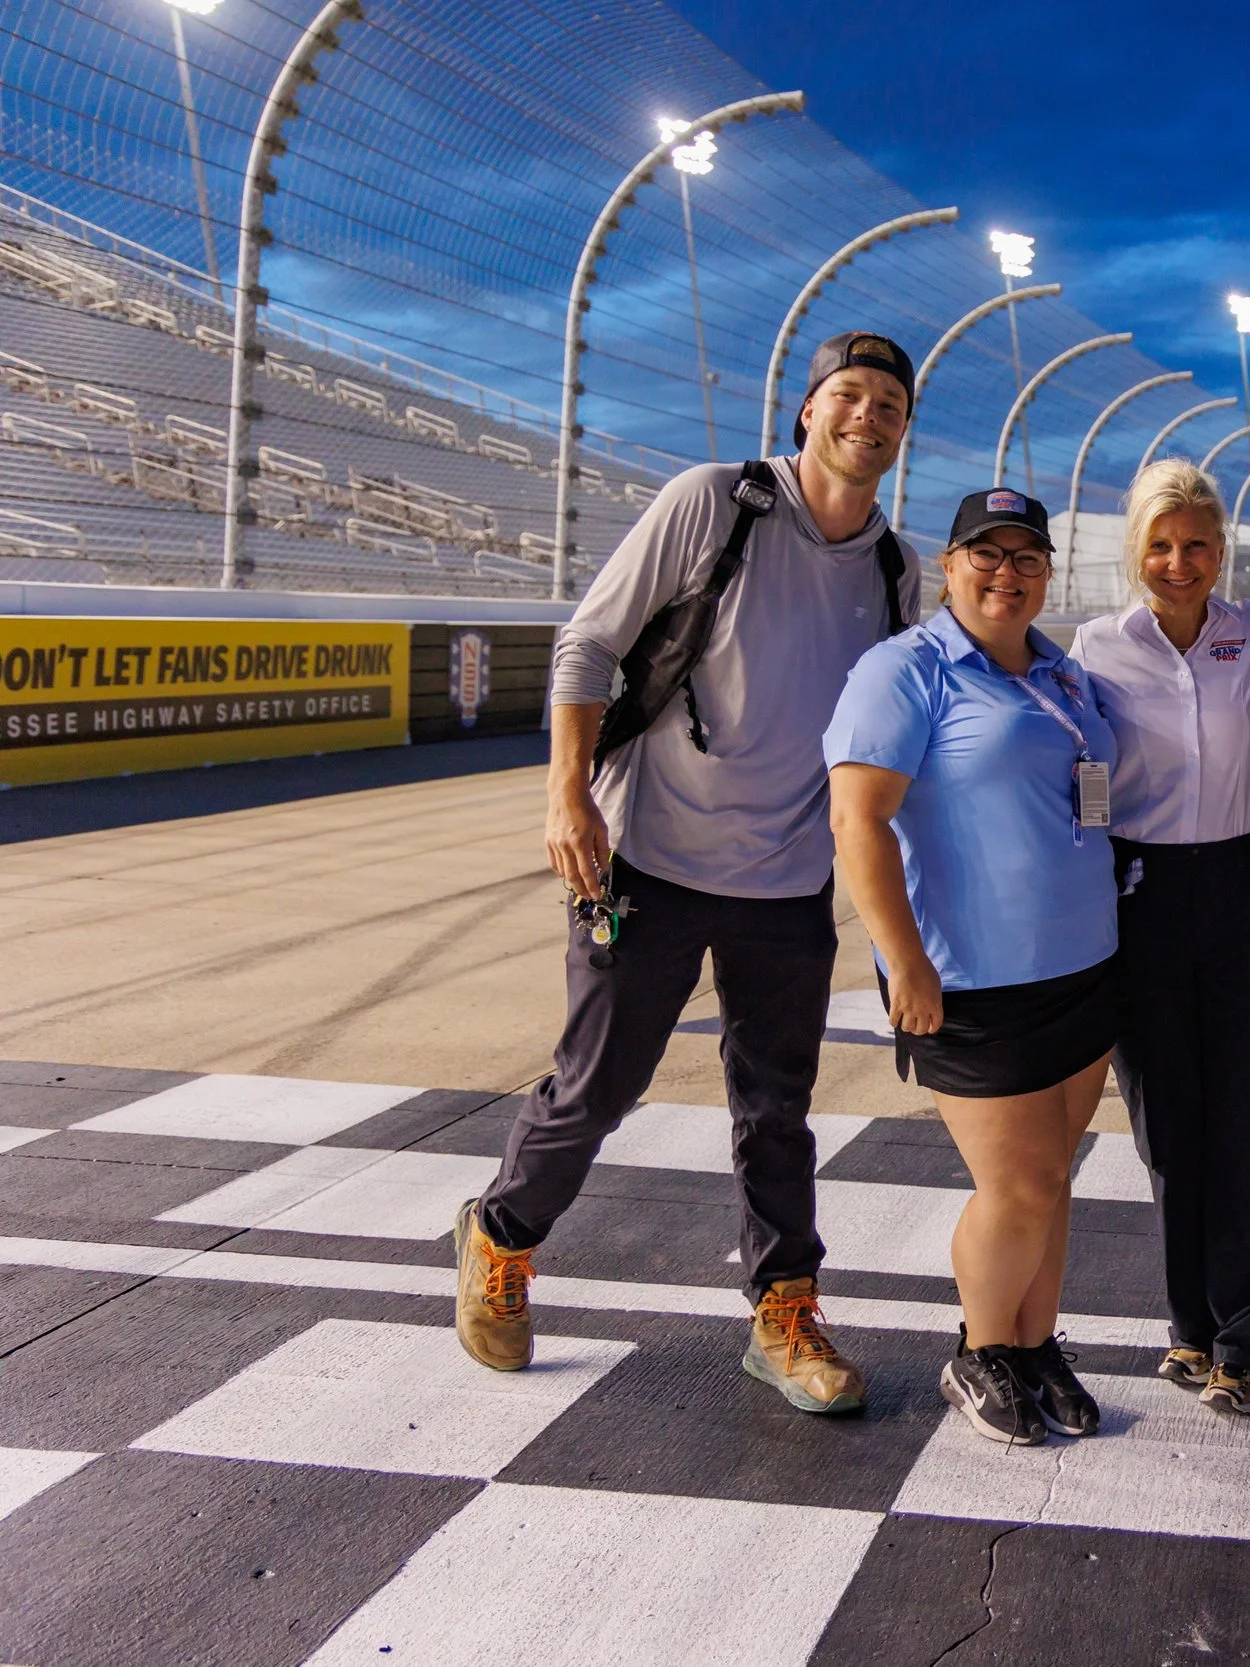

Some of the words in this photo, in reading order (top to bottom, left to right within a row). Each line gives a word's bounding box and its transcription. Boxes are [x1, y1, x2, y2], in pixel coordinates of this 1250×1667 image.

[1209, 647, 1241, 657] GRAND
[1216, 654, 1237, 662] PRIX
[0, 644, 88, 691] ON'T
[95, 647, 151, 687] LET
[157, 645, 228, 684] FANS
[235, 645, 309, 681] DRIVE
[314, 644, 392, 678] DRUNK
[7, 712, 78, 738] SSEE
[94, 704, 204, 731] HIGHWAY
[216, 700, 295, 723] SAFETY
[305, 695, 371, 717] OFFICE
